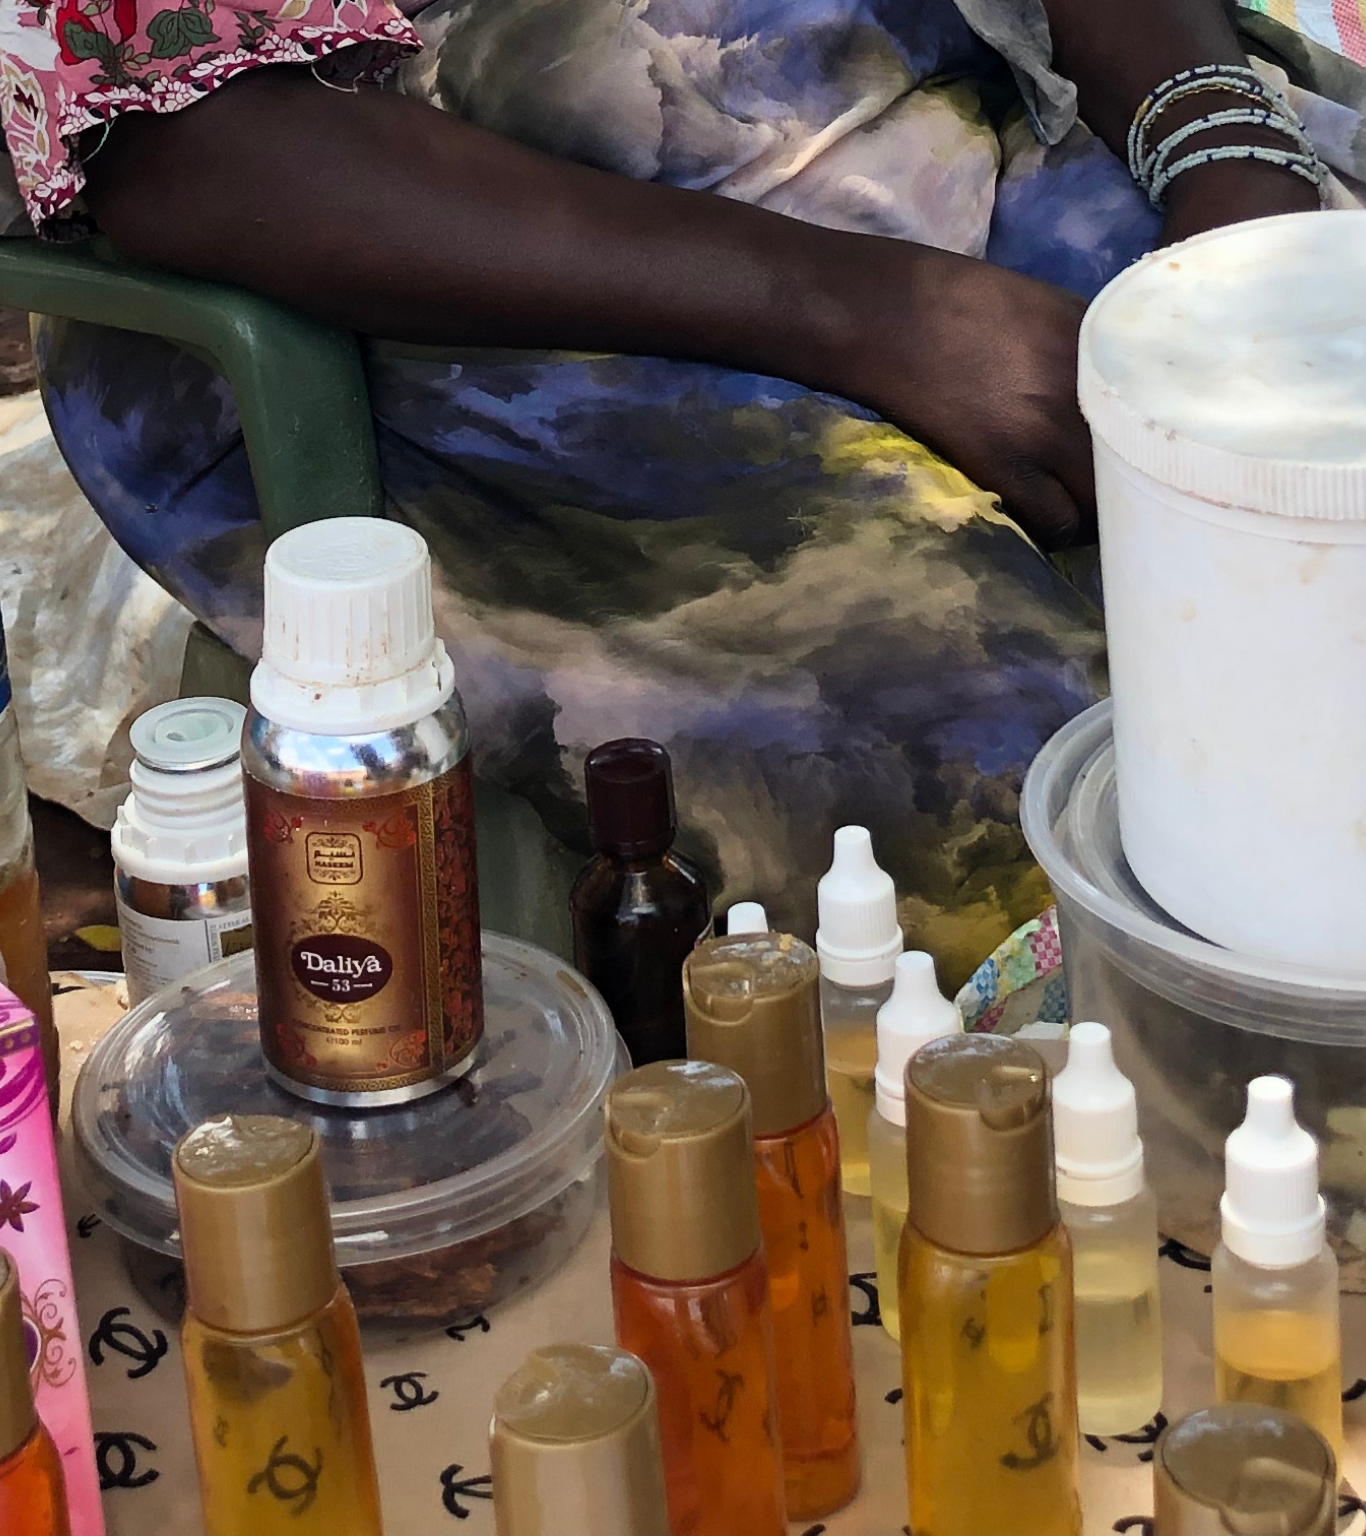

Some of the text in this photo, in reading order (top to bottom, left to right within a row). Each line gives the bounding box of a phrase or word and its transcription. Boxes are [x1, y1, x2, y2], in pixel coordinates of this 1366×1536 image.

[314, 861, 354, 869] NASEEM
[300, 951, 383, 979] Daliya
[331, 978, 351, 992] 53
[351, 1026, 387, 1036] PERFUME
